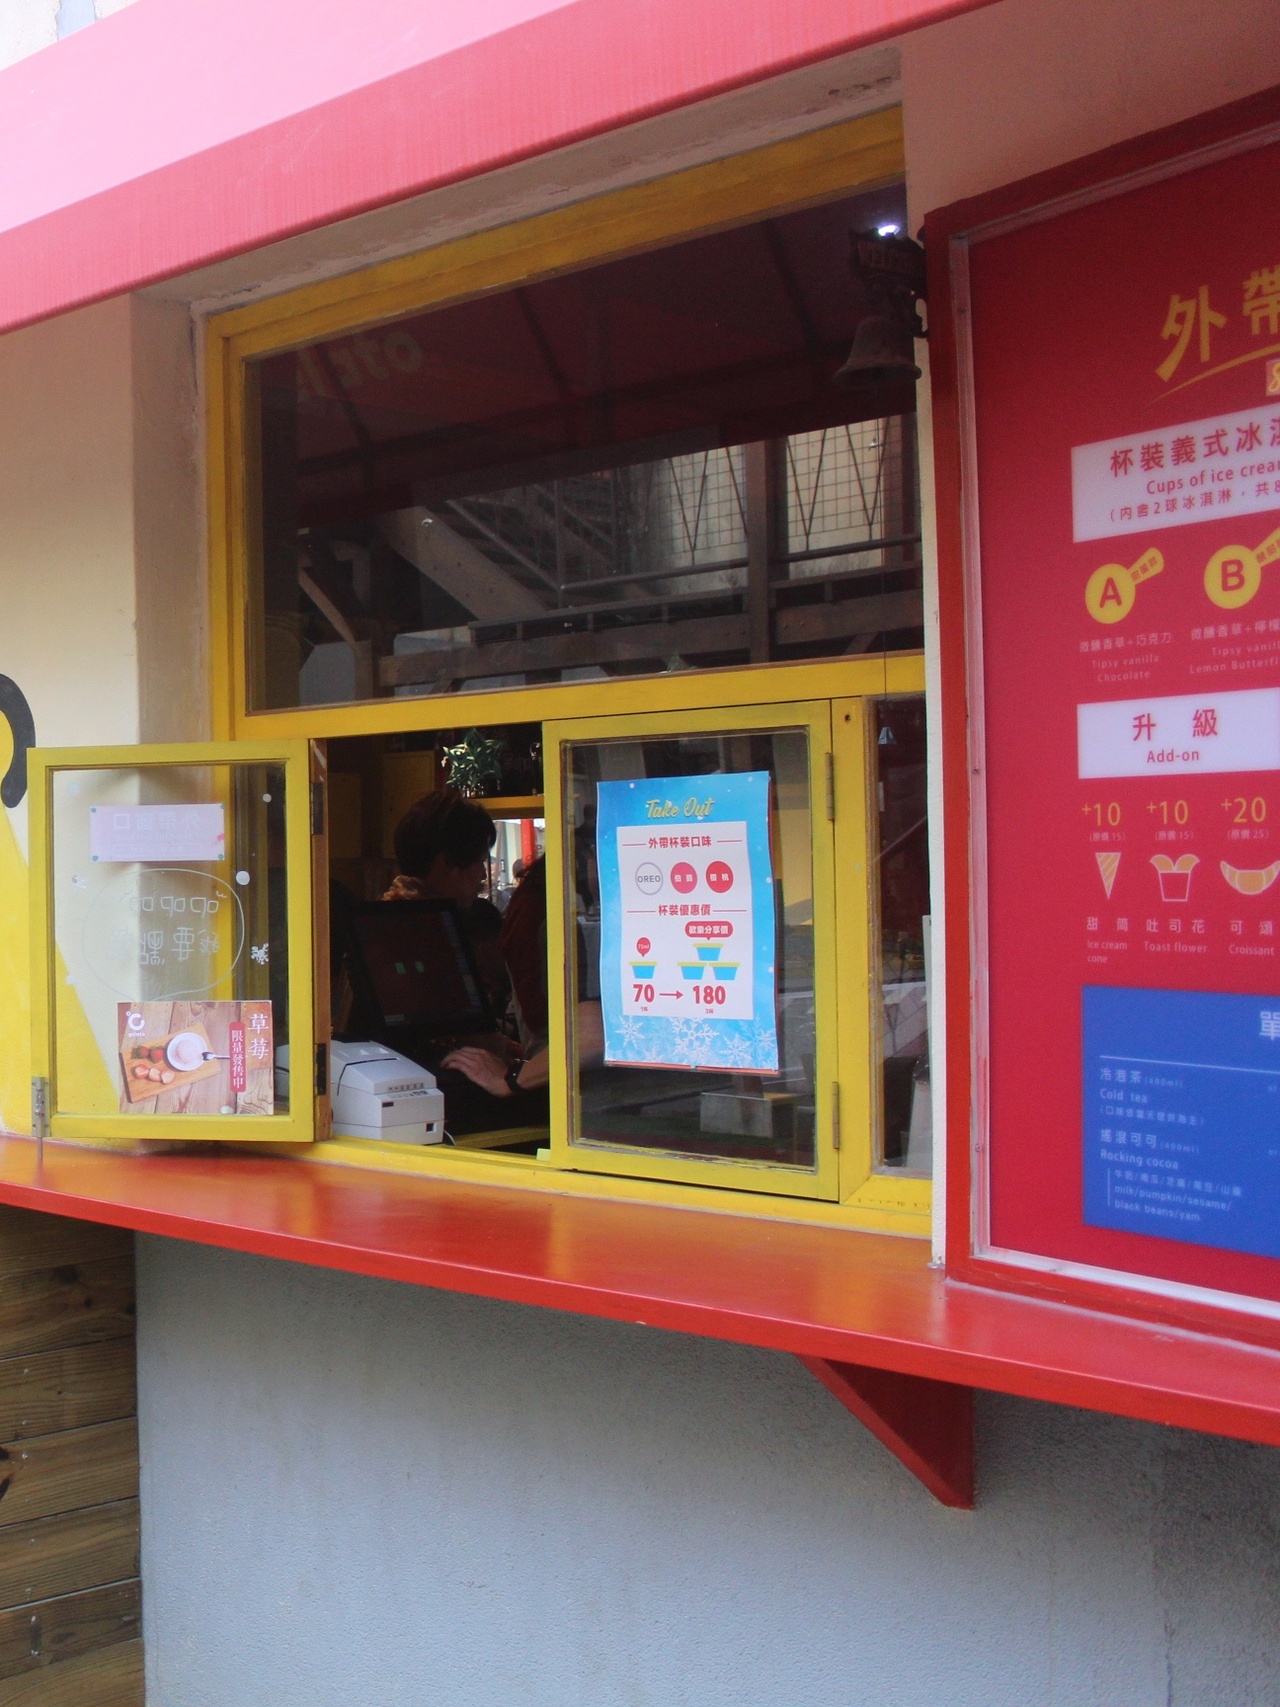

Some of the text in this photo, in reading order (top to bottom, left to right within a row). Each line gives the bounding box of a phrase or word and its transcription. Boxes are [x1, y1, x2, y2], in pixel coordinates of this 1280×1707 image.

[1146, 460, 1280, 496] Cups of ice crea
[1221, 559, 1246, 592] B
[1099, 577, 1122, 609] A
[1132, 708, 1218, 742] 升級
[1147, 749, 1200, 763] Add-on
[646, 797, 715, 819] Take Out
[1081, 801, 1121, 827] +10
[1146, 799, 1189, 825] +10
[1221, 796, 1267, 824] +20
[648, 835, 712, 849] 外帶杯裝口味
[637, 875, 661, 883] OREO
[658, 904, 711, 916] 杯裝優惠價
[1146, 918, 1205, 934] 吐司花
[1101, 941, 1128, 950] cream
[1144, 940, 1207, 953] Toast flower
[1229, 944, 1274, 956] Croissant
[1087, 955, 1108, 964] cone
[633, 984, 655, 1003] 70
[692, 985, 726, 1005] 180
[247, 1013, 269, 1060] 草莓
[1099, 1088, 1148, 1104] Cold tea
[1100, 1149, 1179, 1170] Rocking cocoa
